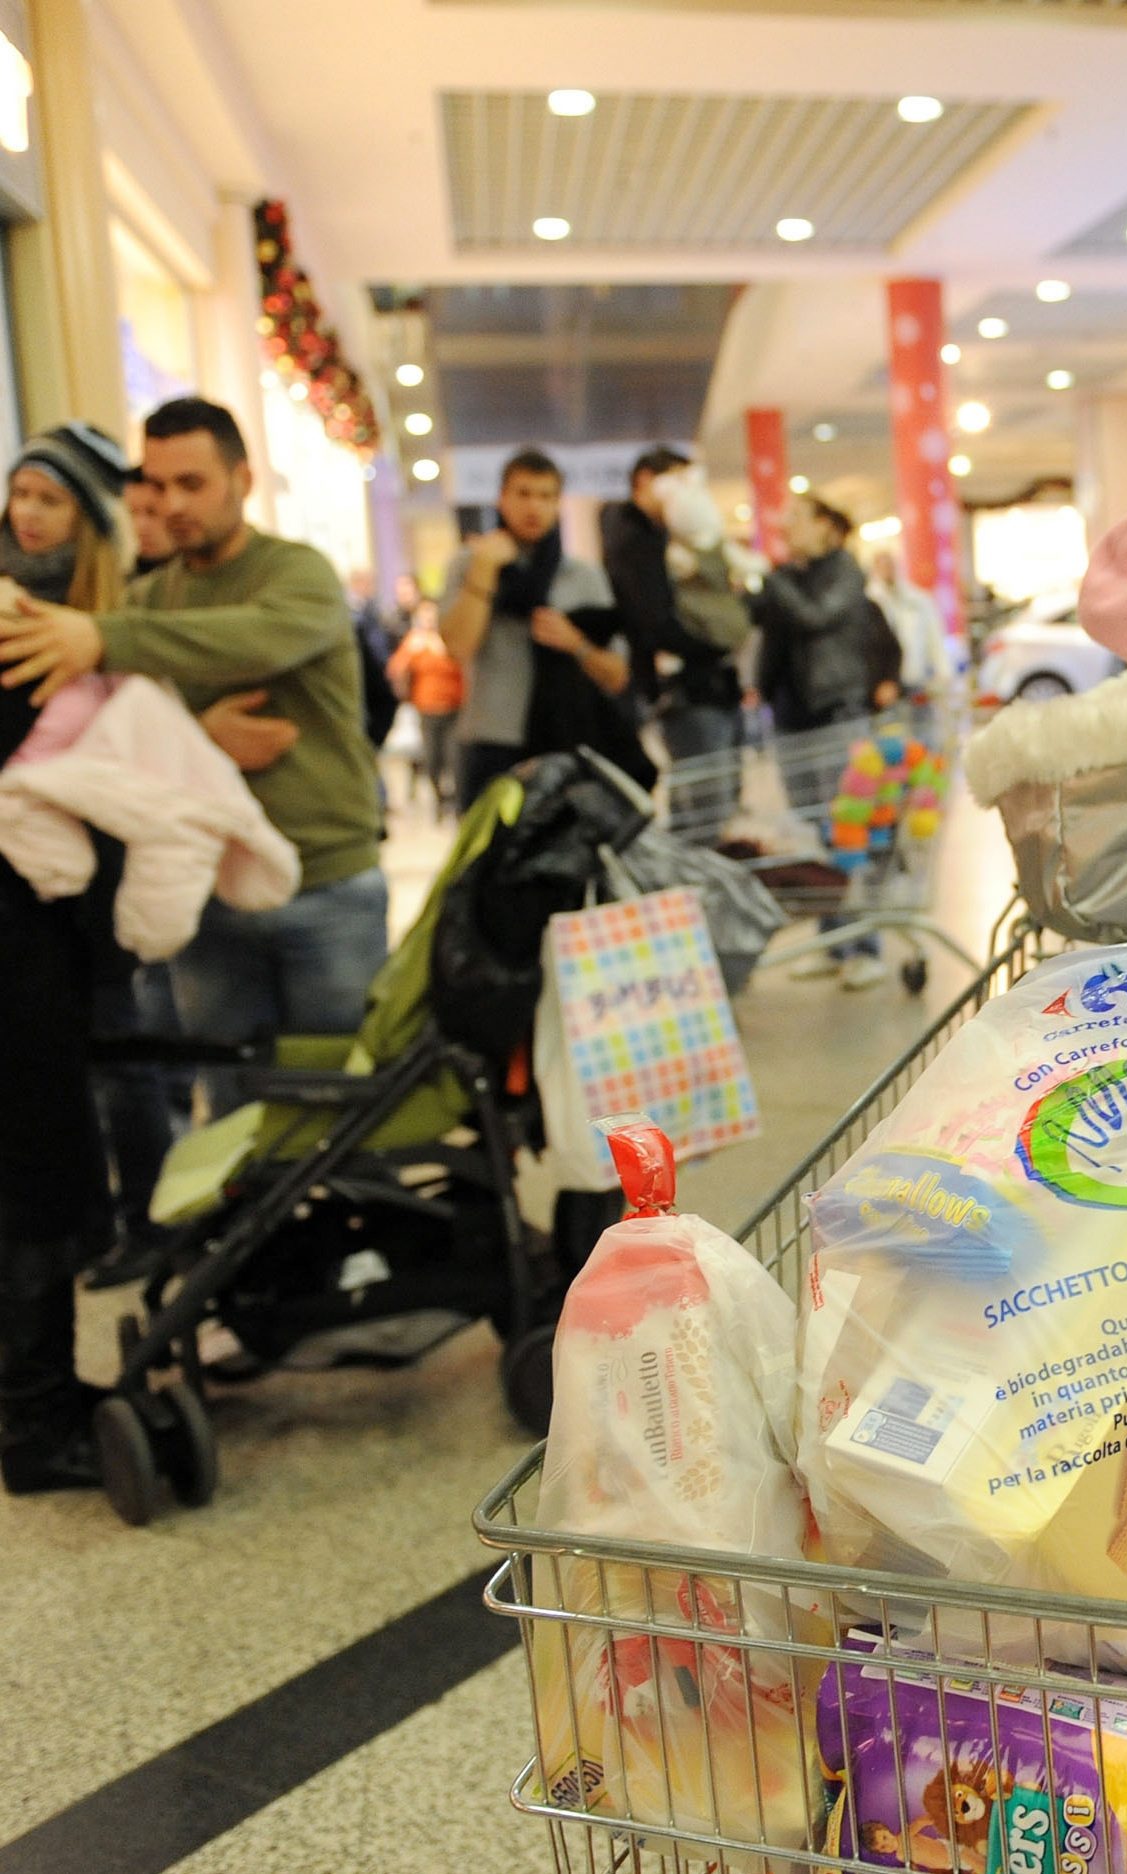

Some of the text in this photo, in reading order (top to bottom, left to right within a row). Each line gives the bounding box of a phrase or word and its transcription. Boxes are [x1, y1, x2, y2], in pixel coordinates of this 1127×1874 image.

[1014, 1062, 1053, 1092] Con
[995, 1386, 1007, 1401] è
[1031, 1390, 1052, 1408] in
[1019, 1400, 1095, 1440] materia
[1027, 1467, 1046, 1483] la
[1052, 1439, 1121, 1477] raccolta
